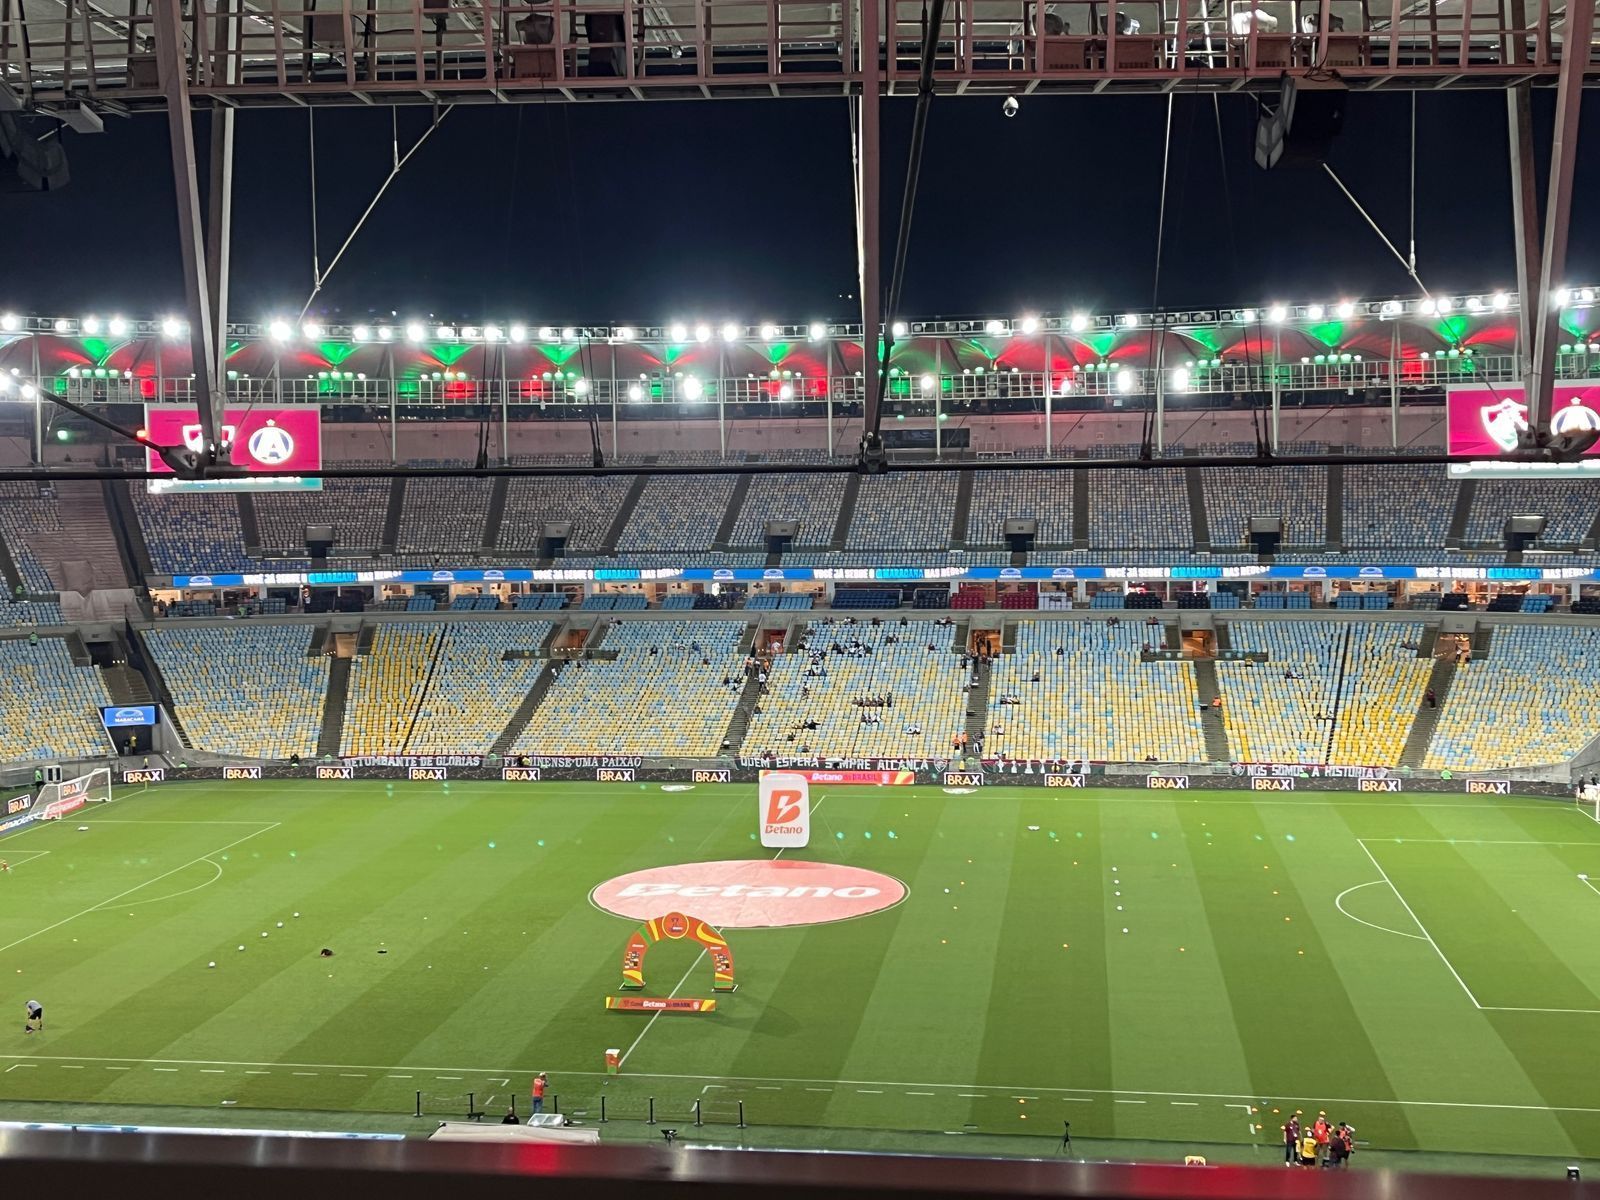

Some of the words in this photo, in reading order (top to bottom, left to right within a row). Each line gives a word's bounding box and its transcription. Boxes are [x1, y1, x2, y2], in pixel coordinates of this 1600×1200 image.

[420, 756, 433, 766] DE
[575, 756, 598, 767] UMA
[741, 757, 770, 768] QUEM
[776, 757, 819, 768] ESPERA
[825, 758, 871, 769] SMPRE
[226, 768, 258, 779] BRAX
[319, 769, 350, 779] BRAX
[412, 770, 443, 779] BRAX
[506, 770, 537, 780] BRAX
[600, 771, 631, 781] BRAX
[1311, 766, 1320, 777] A
[127, 771, 161, 783] BRAX
[696, 772, 727, 782] BRAX
[811, 773, 843, 781] Betano
[948, 775, 980, 785] BRAX
[1048, 776, 1082, 787] BRAX
[1151, 777, 1185, 788] BRAX
[1255, 780, 1290, 790] BRAX
[1361, 780, 1397, 791] BRAX
[1470, 782, 1506, 794] BRAX
[9, 796, 29, 813] BRAX
[765, 825, 802, 834] Betano
[615, 883, 880, 898] Betano
[643, 1000, 666, 1008] Betano
